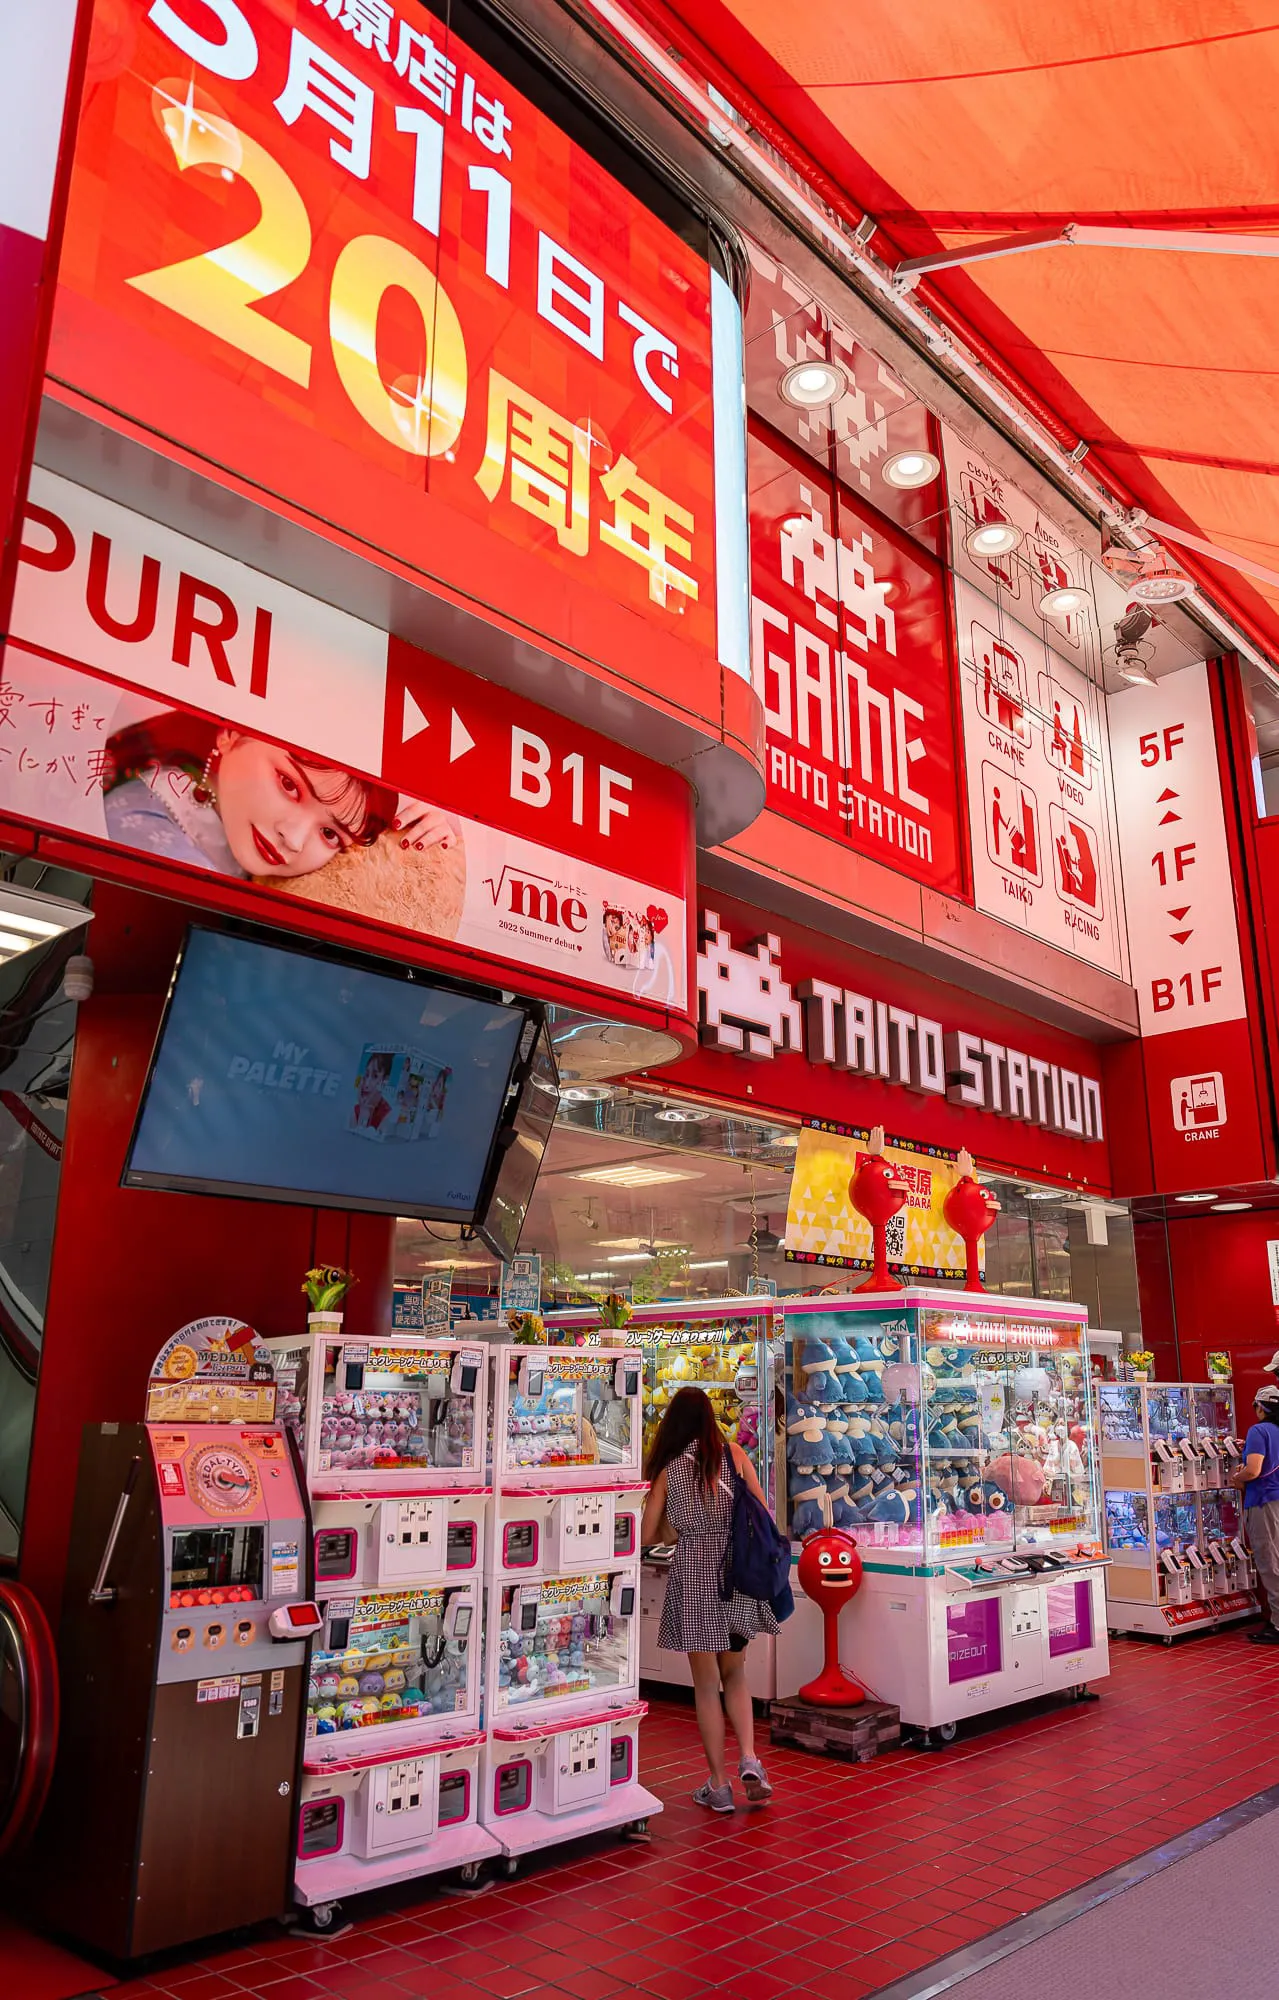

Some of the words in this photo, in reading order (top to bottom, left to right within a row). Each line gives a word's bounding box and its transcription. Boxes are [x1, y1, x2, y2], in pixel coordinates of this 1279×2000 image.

[309, 0, 512, 162] 原店は
[125, 106, 699, 609] 20周年
[988, 733, 1026, 768] CRANE
[1139, 723, 1186, 768] 5F
[509, 724, 633, 838] B1F
[1057, 777, 1085, 807] VIDEO
[766, 744, 830, 807] AITO
[837, 783, 933, 864] STATION
[1151, 843, 1197, 887] 1F
[1001, 876, 1034, 907] TAIKO
[498, 919, 518, 933] 2022
[519, 926, 553, 944] Summer
[1064, 909, 1101, 941] RACING
[1150, 966, 1223, 1013] B1F
[226, 1054, 343, 1098] PALETTE
[809, 978, 946, 1096] TAITO
[955, 1029, 1104, 1143] STATION
[1183, 1129, 1221, 1143] CRANE
[893, 1162, 932, 1196] 葉原
[905, 1195, 932, 1210] ABARA
[883, 1324, 907, 1333] TWIN
[975, 1321, 1006, 1344] TAITO
[1010, 1324, 1054, 1347] STATION
[198, 1351, 247, 1364] MEDAL
[1049, 1622, 1081, 1639] RIZEOUT
[950, 1644, 988, 1662] RIZEOUT
